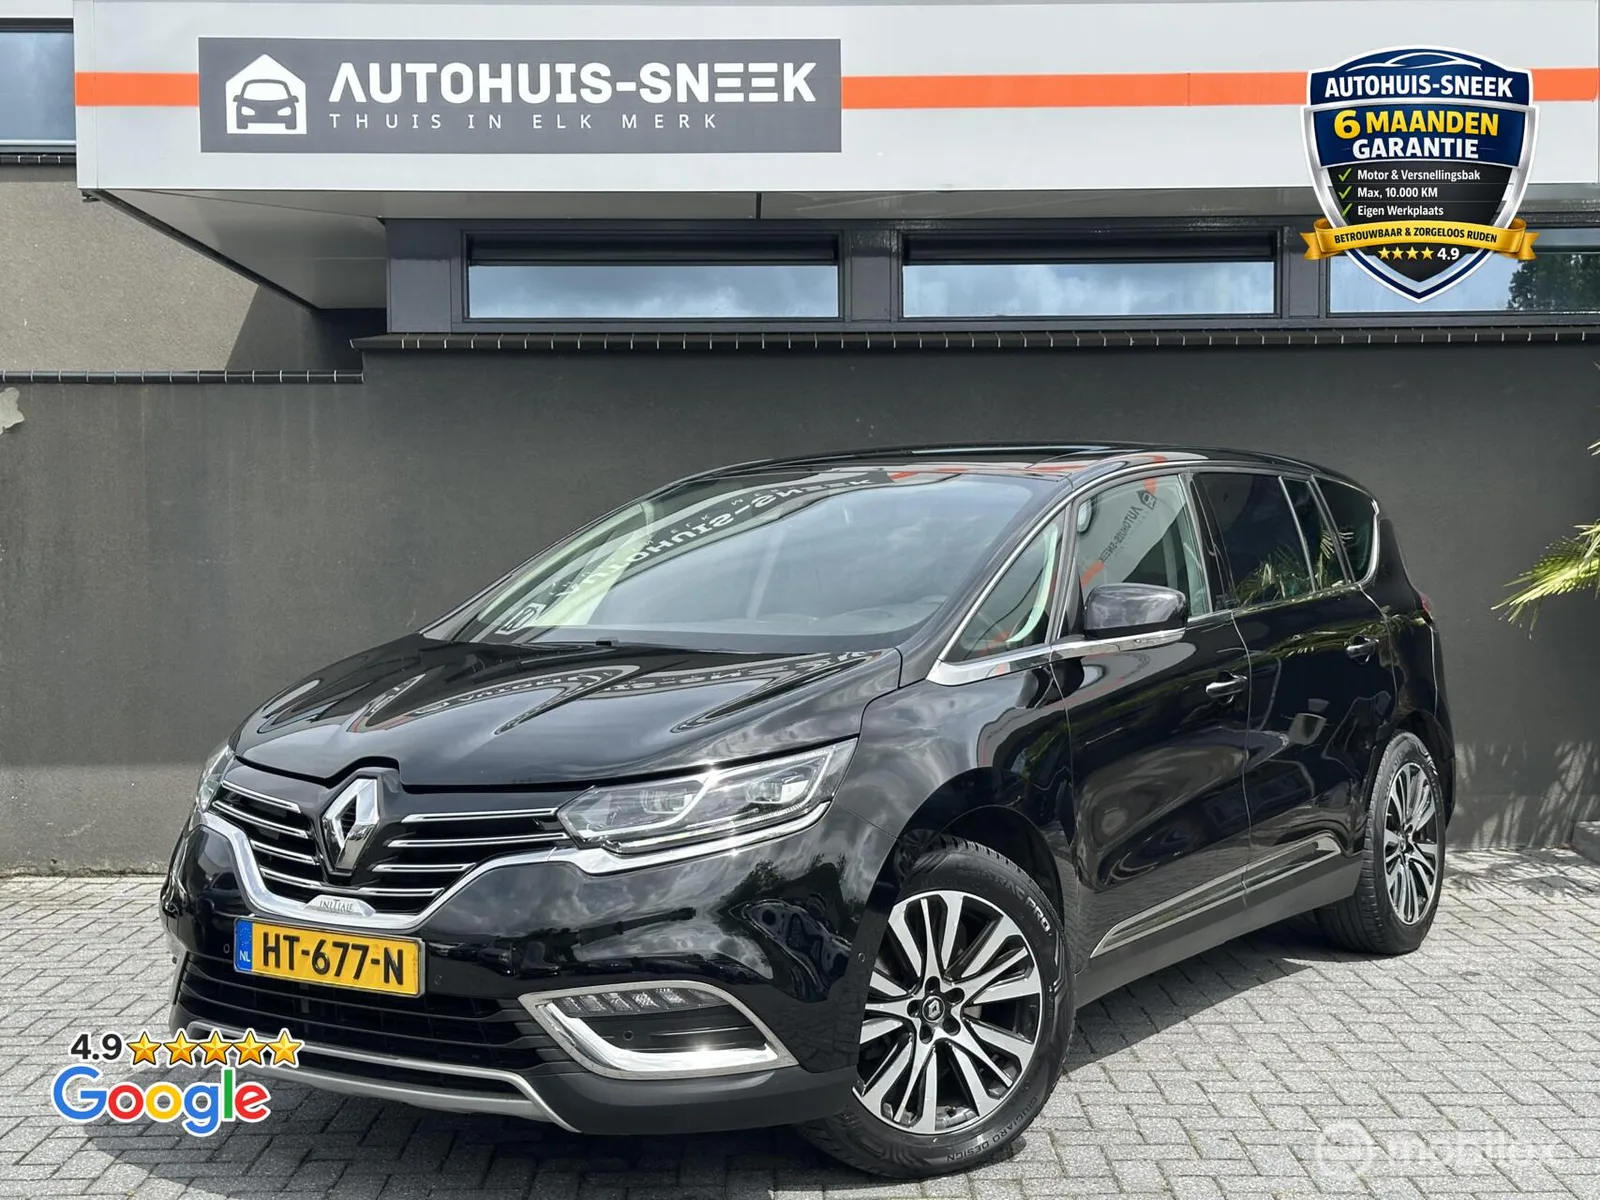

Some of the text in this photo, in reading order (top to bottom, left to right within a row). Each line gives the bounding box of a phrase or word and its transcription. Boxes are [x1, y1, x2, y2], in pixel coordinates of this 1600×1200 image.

[329, 62, 816, 104] AUTOHUIS-SNEEK
[329, 114, 716, 129] THUIS IN ELK MERK
[239, 950, 251, 962] NL
[262, 932, 404, 985] HT-677-N
[946, 1141, 990, 1162] DESIGN
